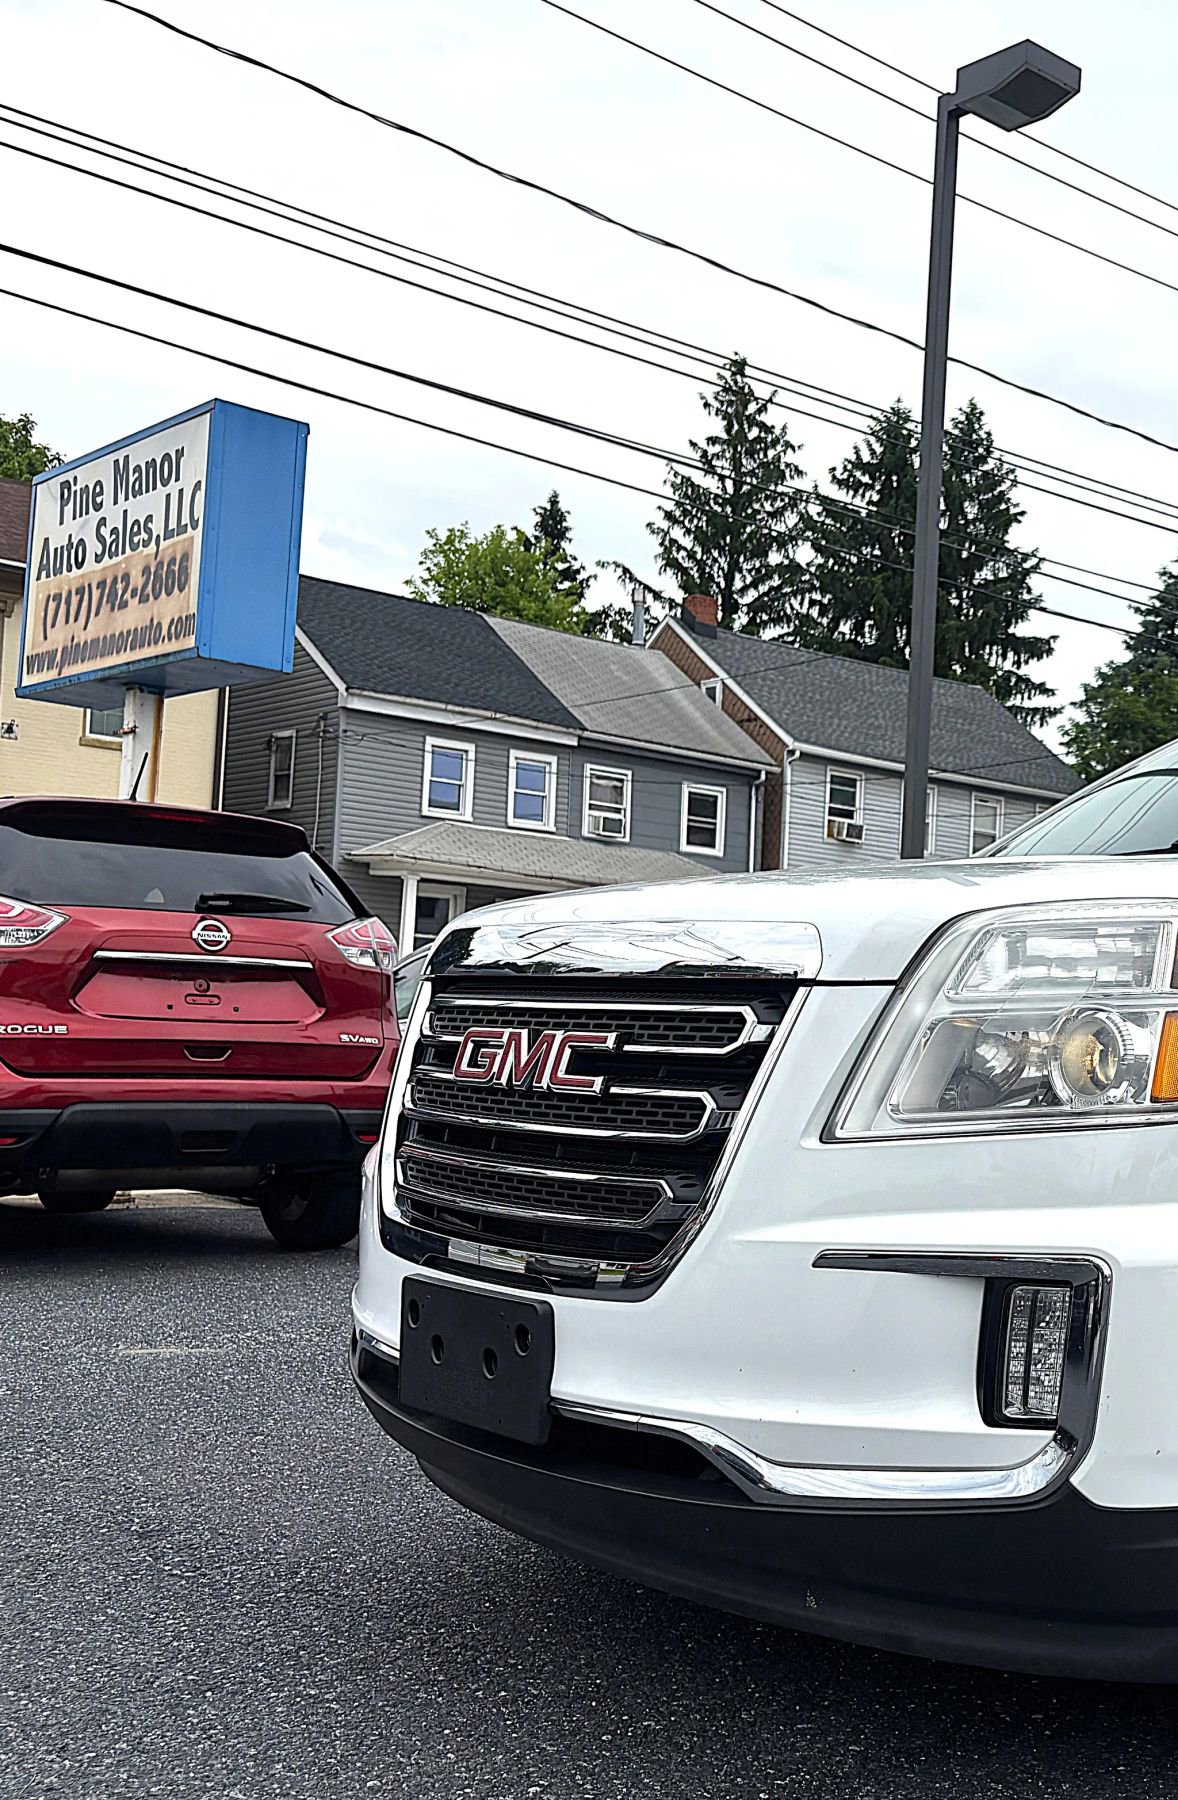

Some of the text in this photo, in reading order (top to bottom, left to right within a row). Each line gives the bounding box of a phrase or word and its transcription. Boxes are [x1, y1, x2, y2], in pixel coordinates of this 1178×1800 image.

[59, 446, 185, 526] Pine Manor
[36, 533, 87, 581] Auto
[197, 932, 228, 940] NISSAN
[453, 1027, 618, 1096] GMC
